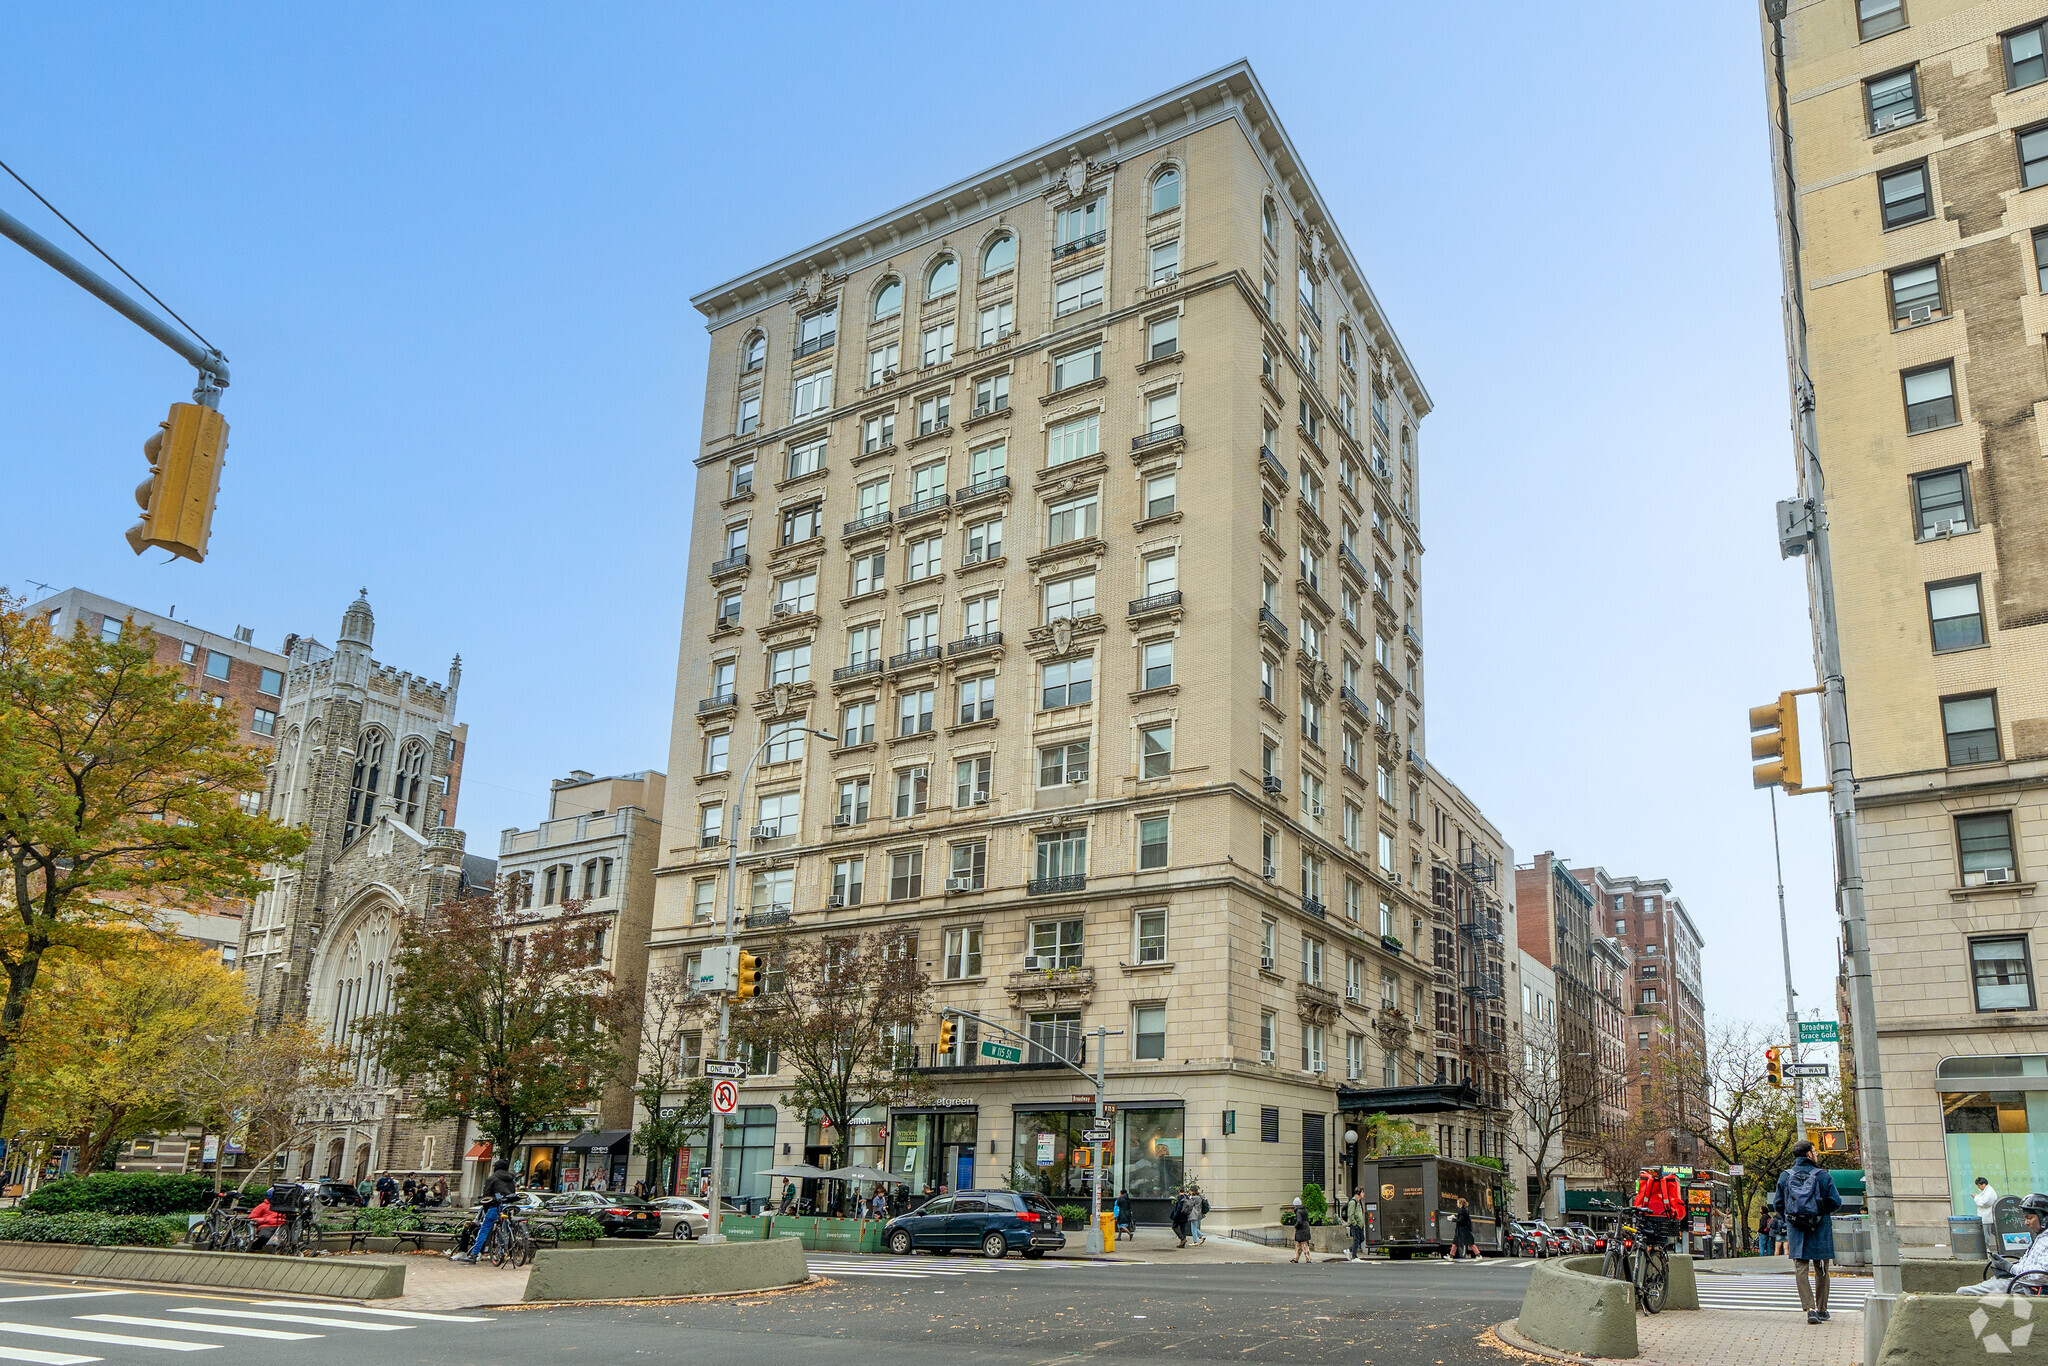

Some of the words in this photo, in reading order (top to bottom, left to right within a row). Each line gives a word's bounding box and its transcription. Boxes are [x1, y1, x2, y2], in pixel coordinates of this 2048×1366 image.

[700, 975, 714, 983] NYC
[1801, 1023, 1833, 1032] Broadway
[992, 1046, 997, 1055] W
[997, 1047, 1005, 1058] 115
[1005, 1049, 1012, 1059] St
[710, 1065, 723, 1073] ONE
[1680, 1166, 1693, 1174] Halal
[1381, 1188, 1394, 1197] ups
